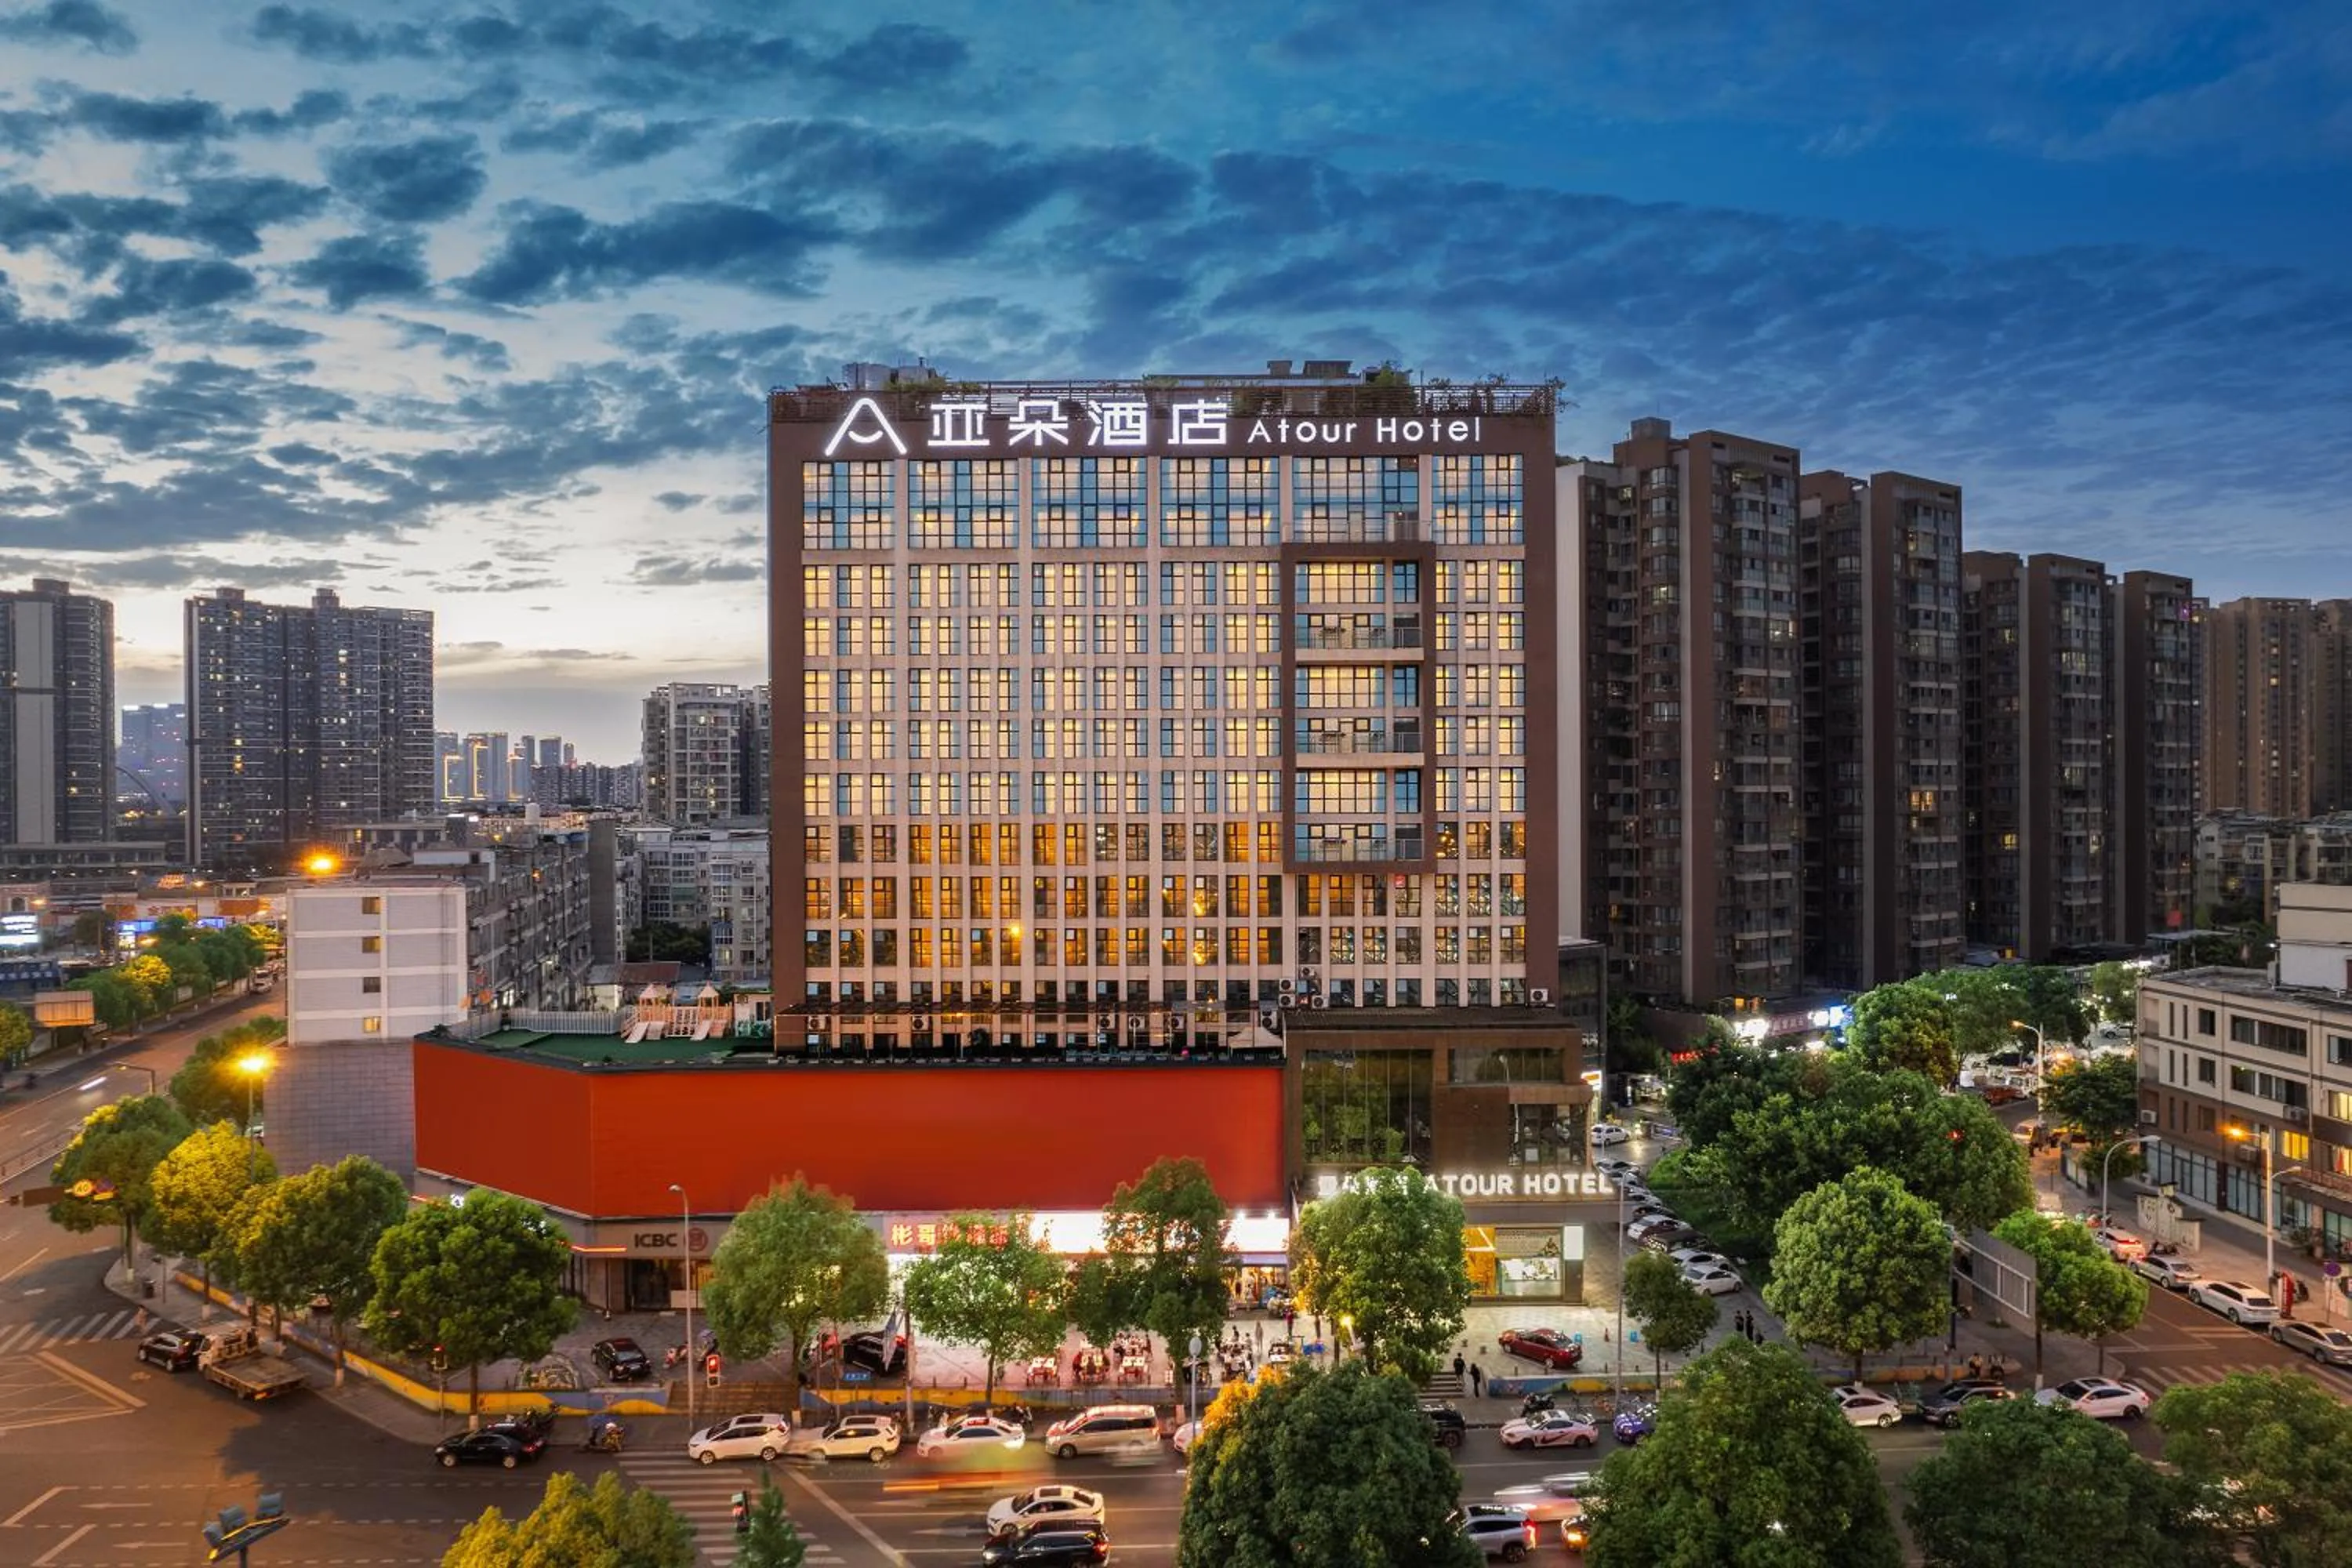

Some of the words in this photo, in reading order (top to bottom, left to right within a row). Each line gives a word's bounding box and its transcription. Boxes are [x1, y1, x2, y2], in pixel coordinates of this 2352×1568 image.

[928, 399, 1227, 447] 亚朵酒店
[1248, 419, 1357, 443] Atour
[1377, 417, 1480, 443] Hotel
[1524, 1174, 1613, 1195] HOTEL
[634, 1233, 678, 1248] ICBC
